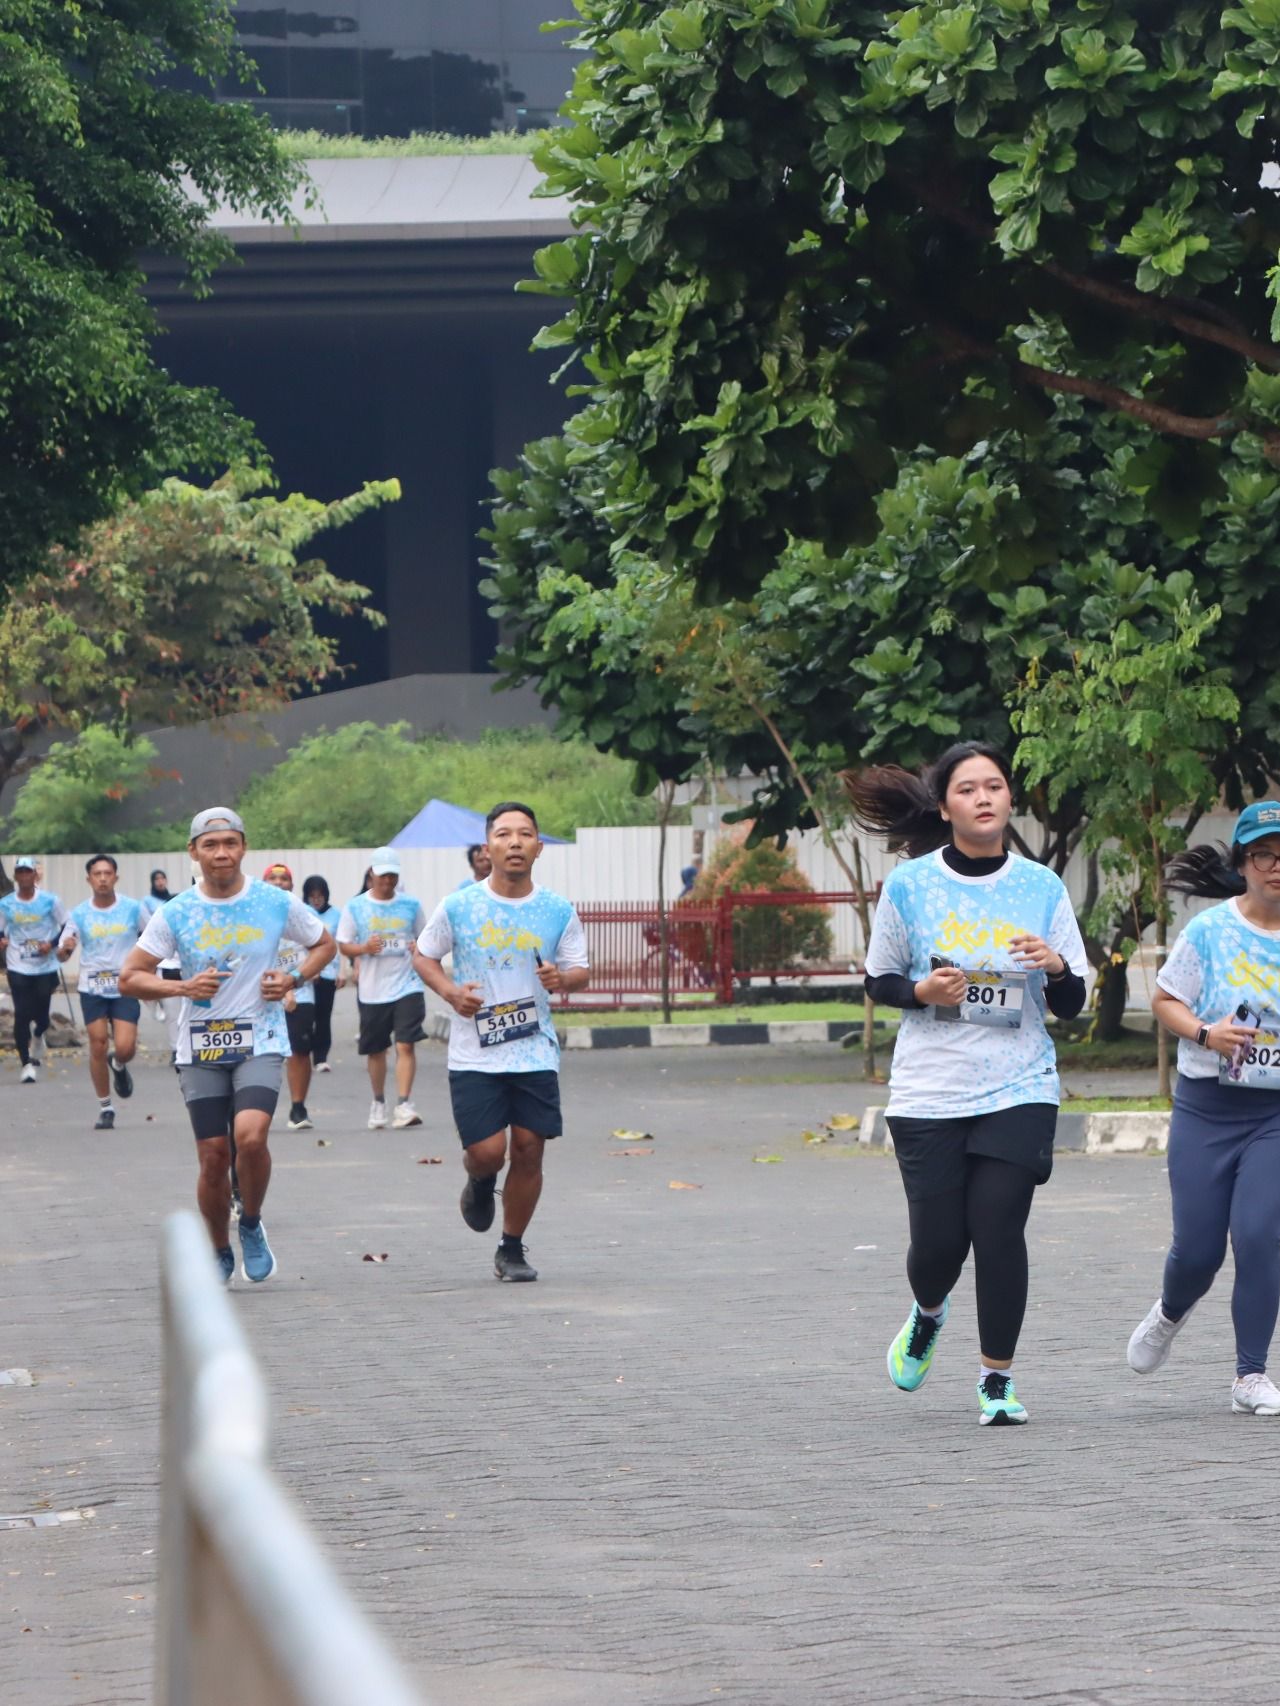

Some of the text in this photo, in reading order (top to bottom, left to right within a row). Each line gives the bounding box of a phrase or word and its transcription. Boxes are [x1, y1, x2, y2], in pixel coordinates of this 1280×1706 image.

[966, 985, 1007, 1006] 801
[487, 1011, 527, 1031] 5410
[202, 1032, 243, 1047] 3609
[487, 1029, 507, 1044] 5K
[199, 1048, 224, 1061] VIP
